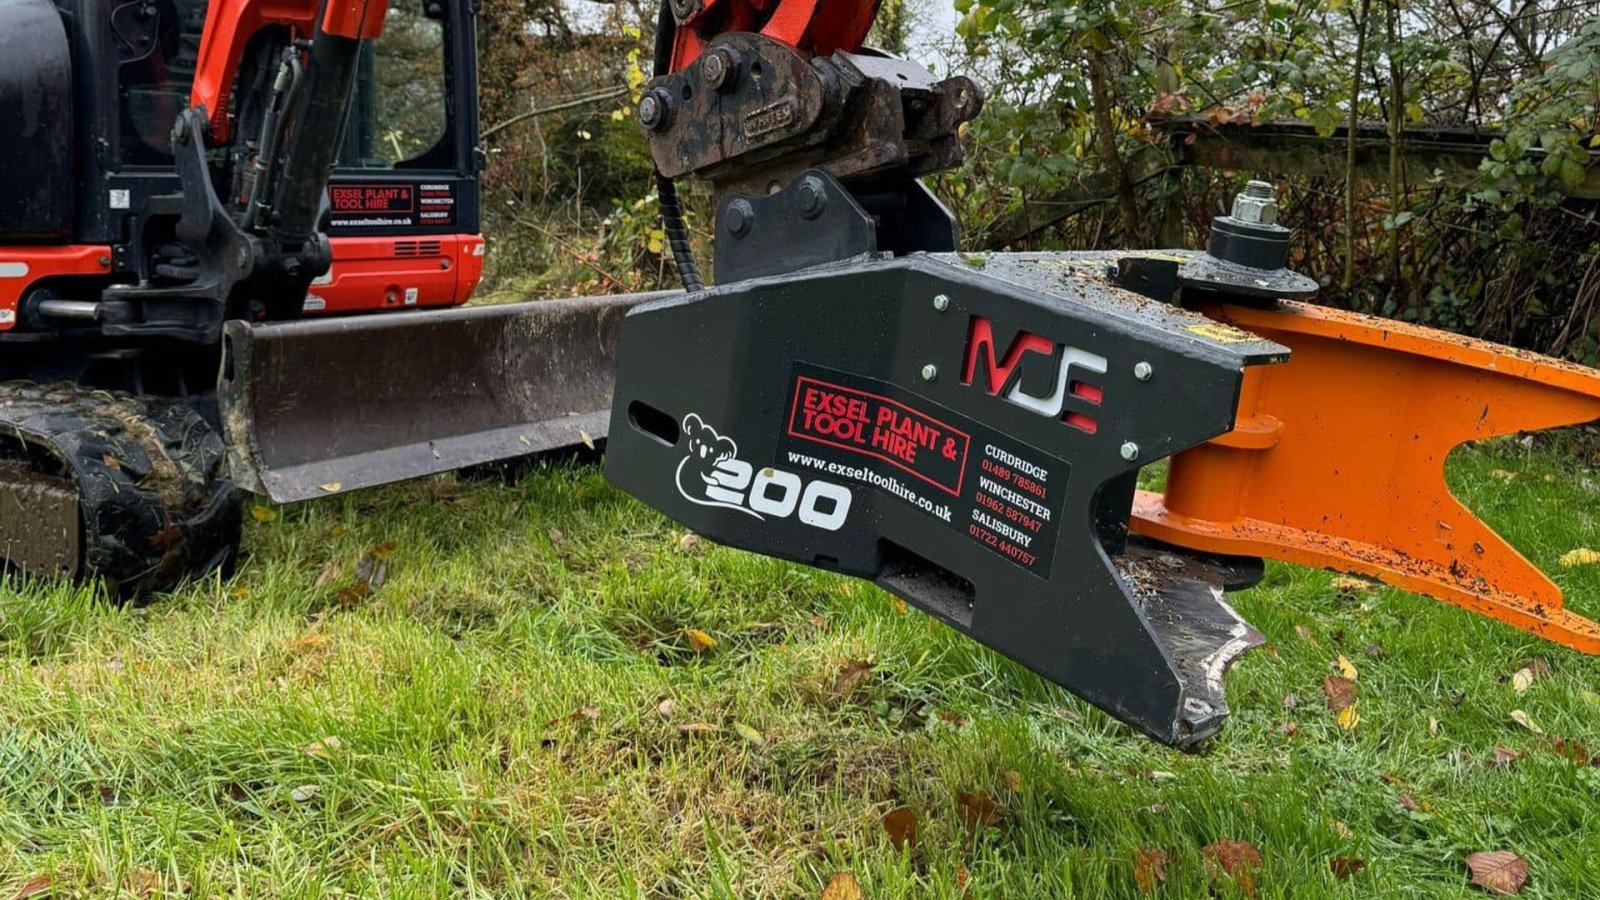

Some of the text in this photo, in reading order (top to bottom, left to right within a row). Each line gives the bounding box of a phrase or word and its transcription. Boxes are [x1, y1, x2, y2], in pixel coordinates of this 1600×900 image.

[333, 188, 364, 199] EXSEL
[365, 188, 399, 199] PLANT
[401, 188, 409, 199] &
[334, 199, 389, 209] TOOL HIRE
[803, 409, 918, 464] TOOL HIRE
[804, 388, 957, 461] EXSEL PLANT &
[982, 459, 1048, 499] 01489 785861
[985, 444, 1048, 482] CURDRIDGE
[705, 458, 852, 531] 200
[788, 451, 952, 522] www.exseltoolhire.co.uk
[980, 476, 1051, 521] WINCHESTER
[972, 509, 1032, 548] SALISBURY
[976, 492, 1042, 532] 01962 587947
[969, 524, 1036, 566] 01722 440757
